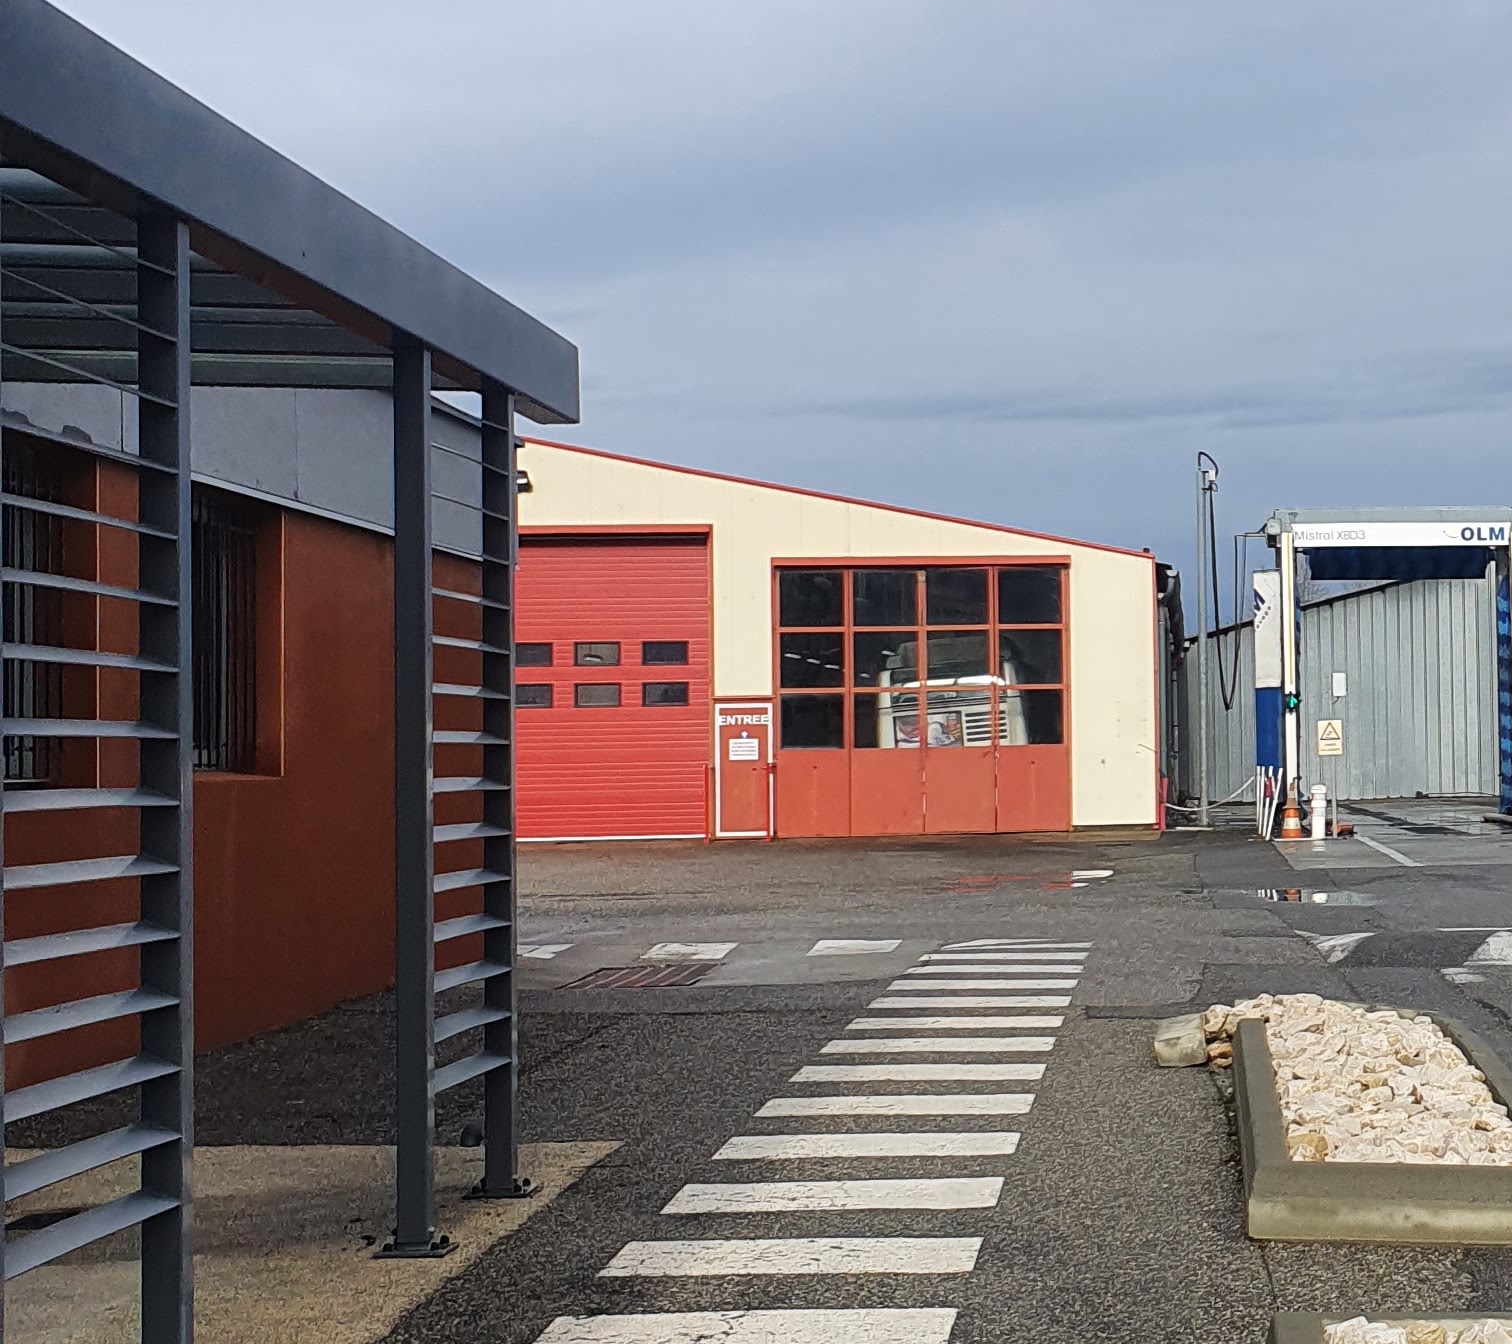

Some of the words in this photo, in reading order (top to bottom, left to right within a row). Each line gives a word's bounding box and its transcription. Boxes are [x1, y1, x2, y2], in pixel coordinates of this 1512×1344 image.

[1294, 530, 1333, 540] Mistral
[1461, 527, 1504, 541] OLM
[718, 714, 770, 725] ENTREE
